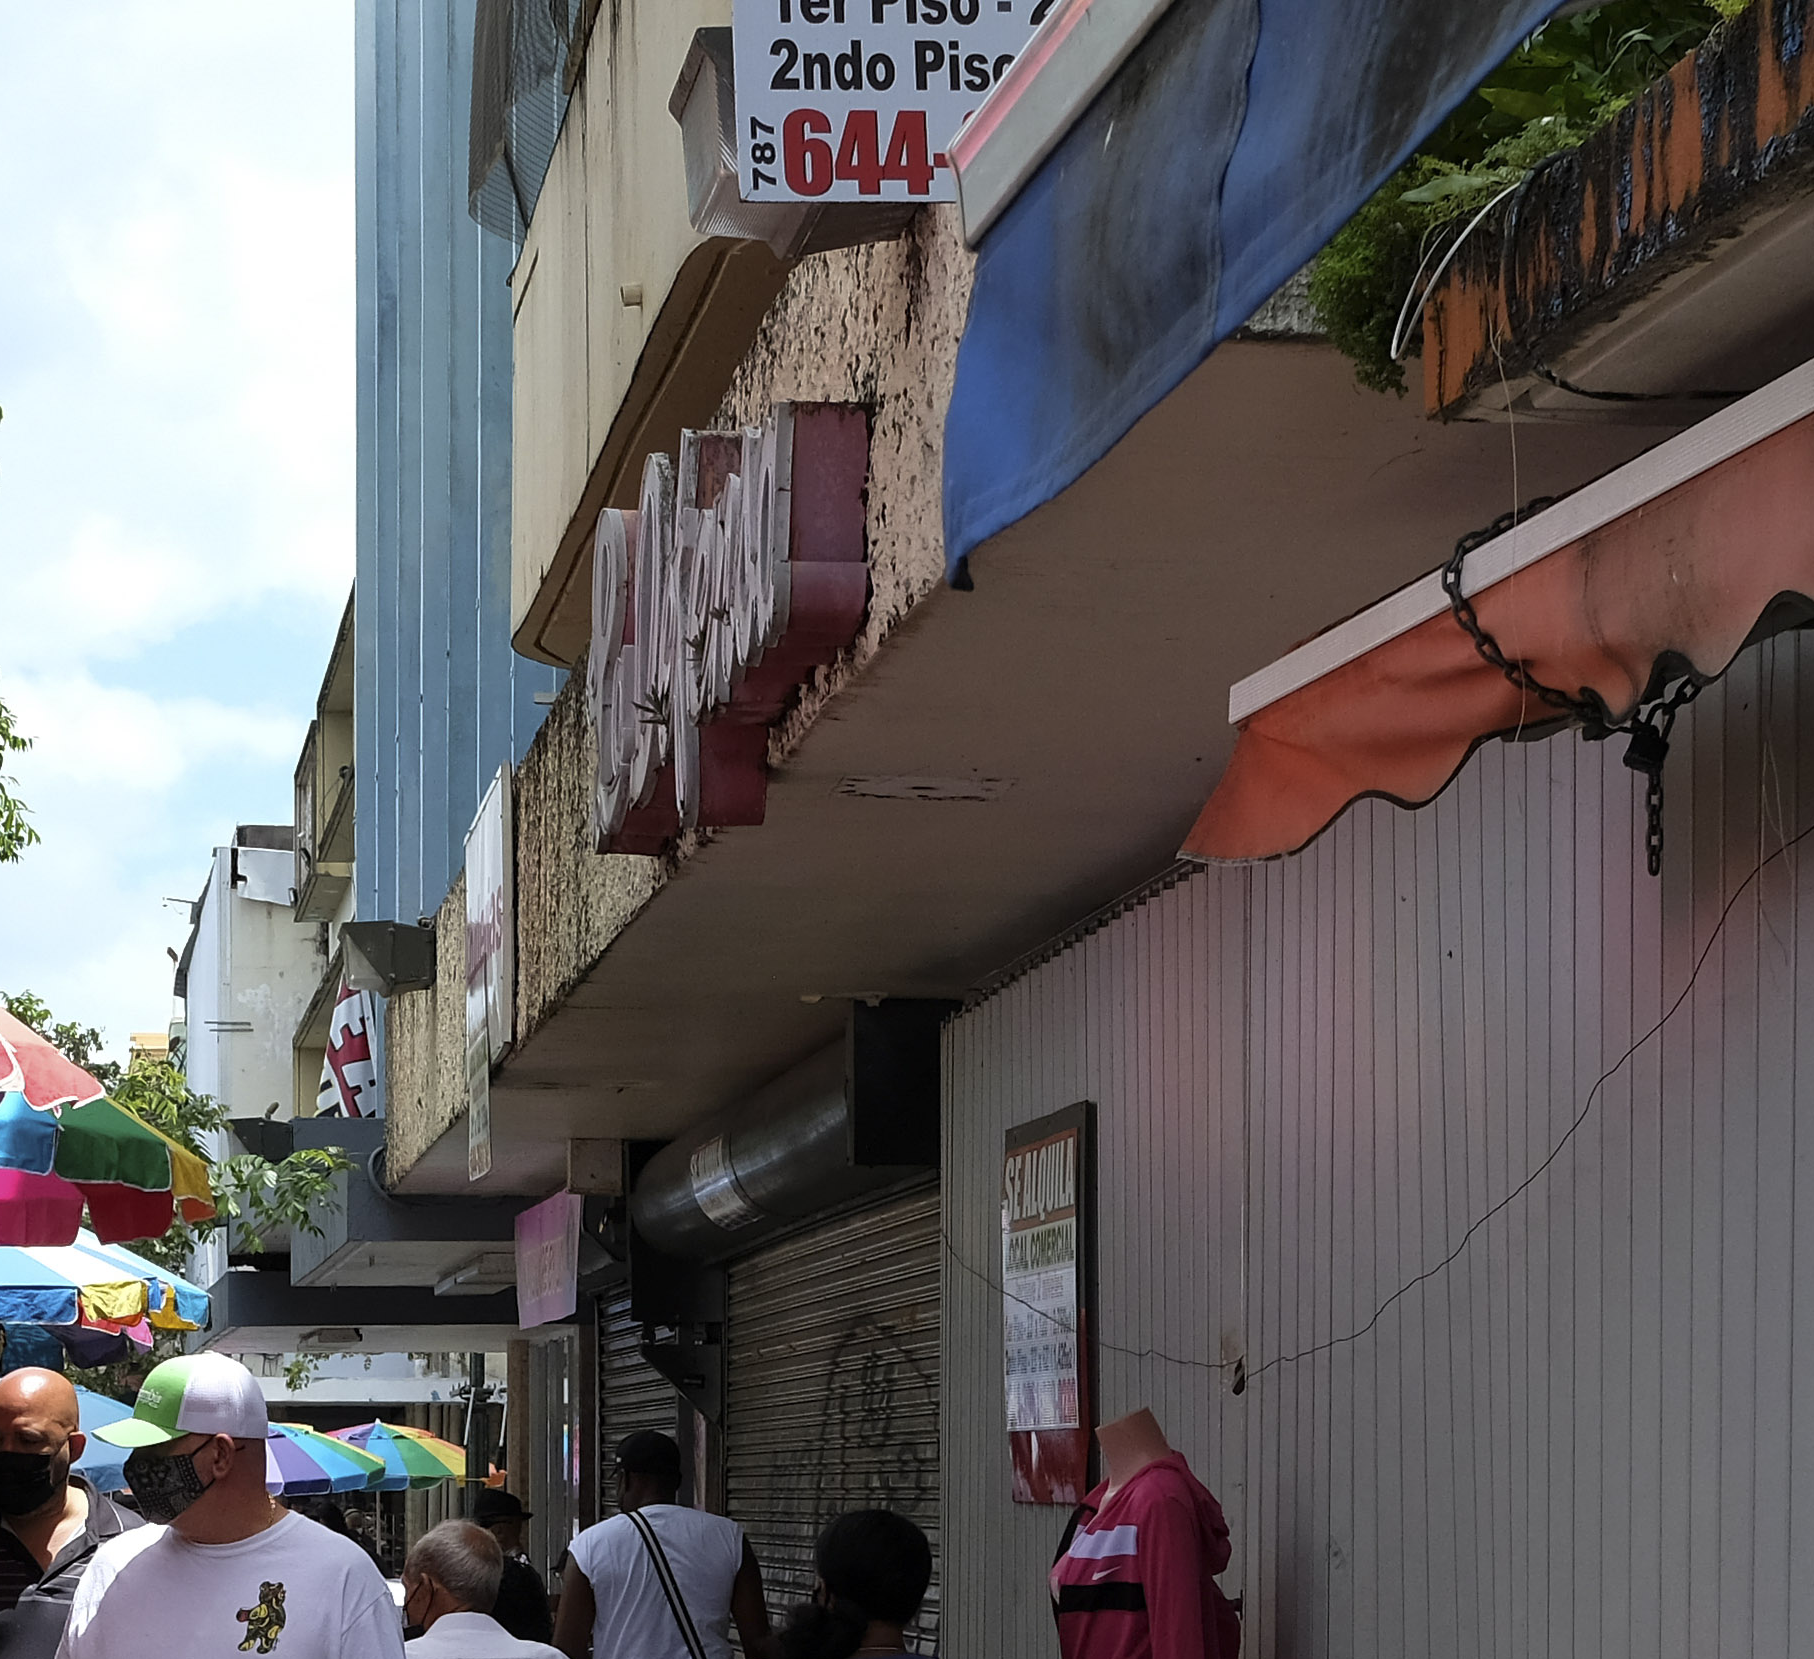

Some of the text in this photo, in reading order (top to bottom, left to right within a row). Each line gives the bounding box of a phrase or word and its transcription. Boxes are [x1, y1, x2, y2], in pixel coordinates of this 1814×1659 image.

[769, 38, 896, 92] 2ndo
[750, 116, 777, 191] 787
[783, 108, 974, 197] 644-
[1004, 1136, 1075, 1221] SE ALQUILA
